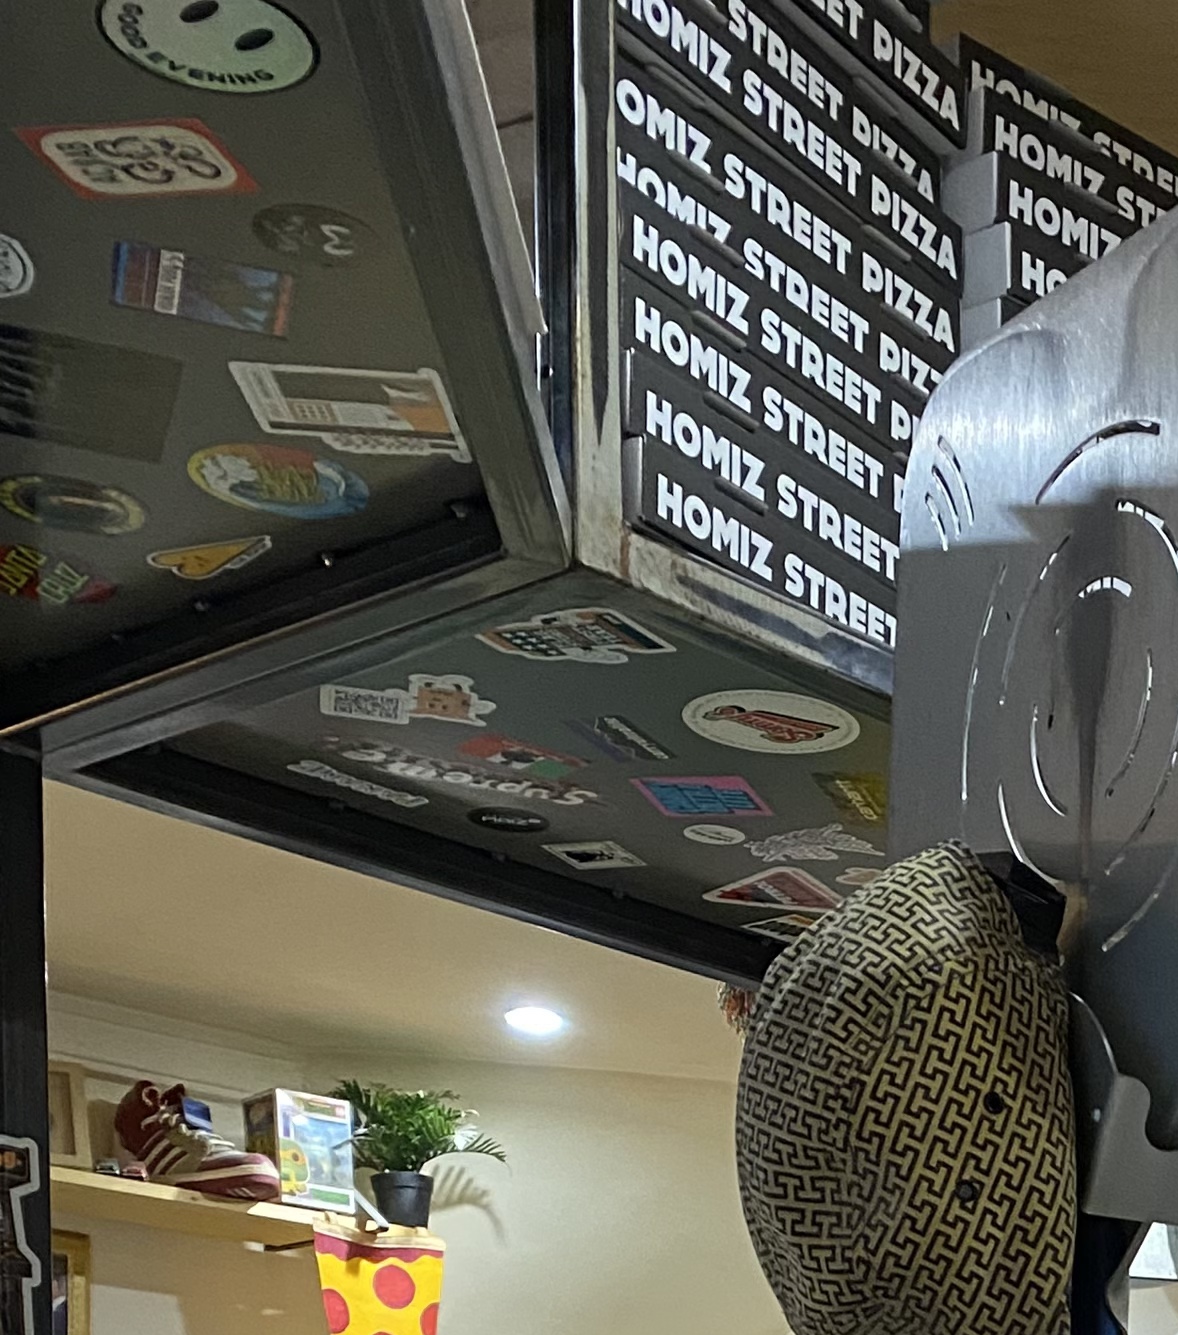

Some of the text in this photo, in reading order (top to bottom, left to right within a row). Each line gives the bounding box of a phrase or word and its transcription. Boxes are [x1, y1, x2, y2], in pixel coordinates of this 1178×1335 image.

[147, 51, 274, 85] EVENING
[729, 0, 933, 203] STREET PIZZA
[874, 20, 959, 130] PIZZA
[996, 115, 1104, 194] HOMIZ
[616, 79, 954, 352] OMIZ STREET PIZZA
[743, 69, 861, 196] STREET
[872, 175, 957, 279] PIZZA
[633, 215, 881, 424] HOMIZ STREET
[636, 297, 883, 498] HOMIZ STREET
[743, 238, 869, 353] STREET
[880, 332, 942, 397] PIZ
[647, 390, 899, 580] HOMIZ STREET
[658, 473, 897, 648] HOMIZ STREET
